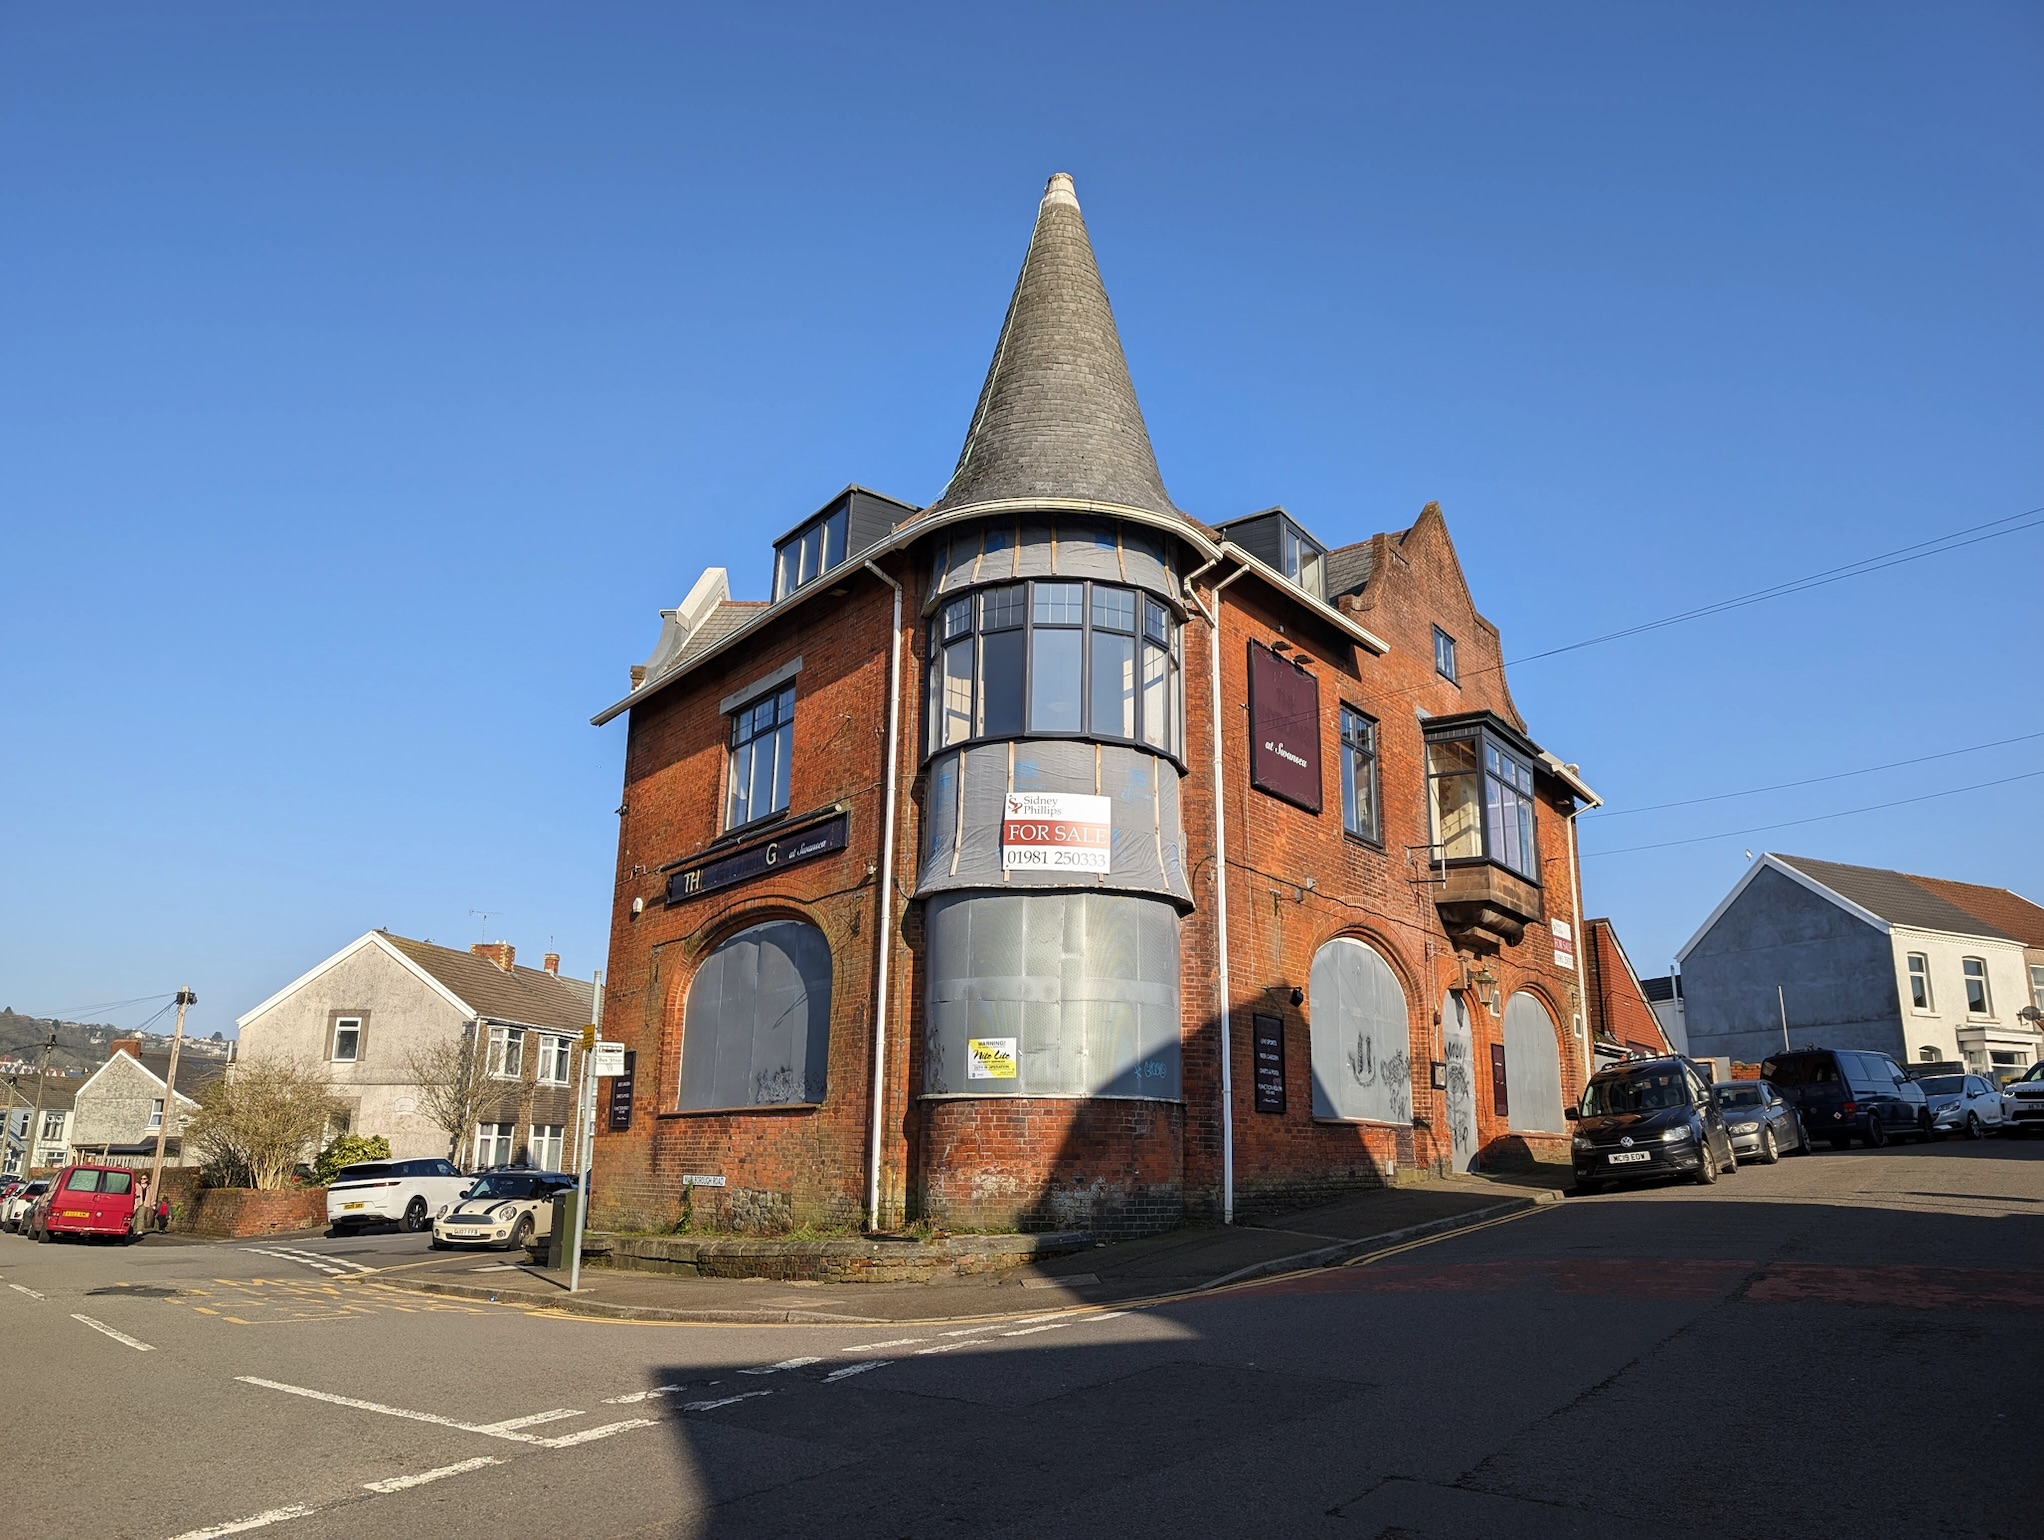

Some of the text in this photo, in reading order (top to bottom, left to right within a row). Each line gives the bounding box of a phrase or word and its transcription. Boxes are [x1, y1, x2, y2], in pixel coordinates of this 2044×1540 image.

[1023, 796, 1058, 807] Sidney
[1024, 806, 1062, 817] Phillips
[1008, 824, 1108, 844] FOR SALE
[1007, 850, 1106, 867] 01981 250333
[973, 1049, 992, 1060] Nite
[685, 1176, 712, 1184] MARBOROUGH
